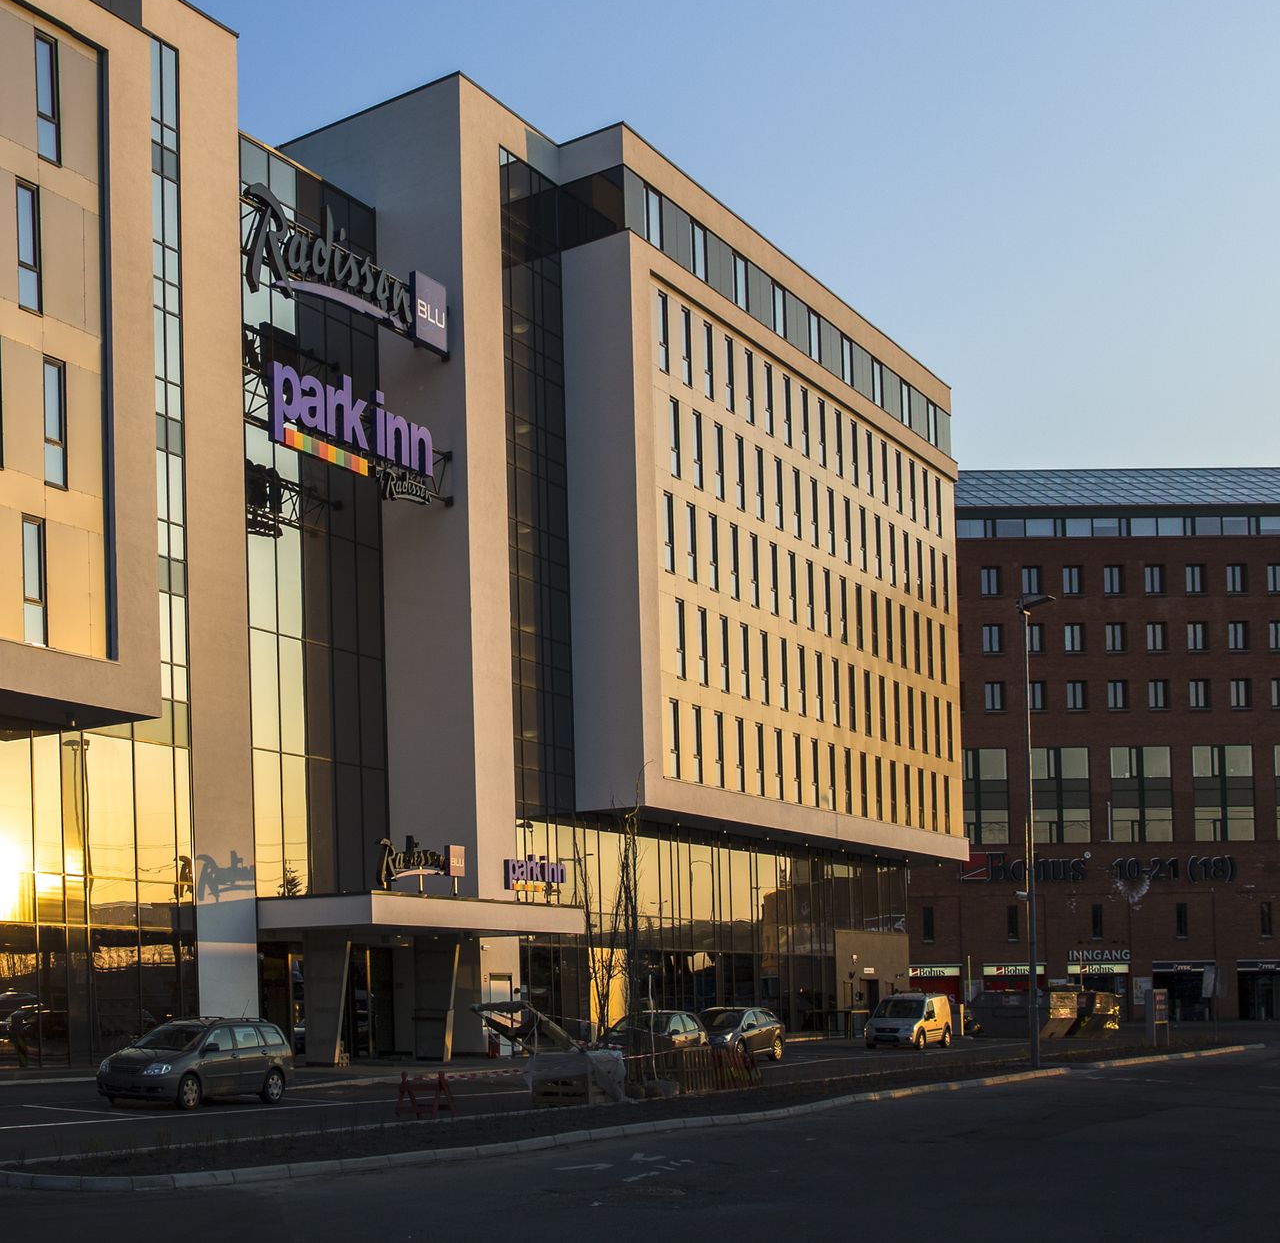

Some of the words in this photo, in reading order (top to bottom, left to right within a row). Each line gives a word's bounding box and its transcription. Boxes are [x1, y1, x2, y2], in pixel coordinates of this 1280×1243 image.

[243, 183, 413, 324] Radisson
[417, 299, 446, 329] BLU
[272, 360, 370, 451] park
[374, 390, 433, 478] inn
[386, 468, 433, 503] Radisson
[450, 857, 464, 867] BLU
[506, 855, 541, 889] park
[542, 857, 567, 884] inn
[1111, 857, 1180, 881] 10-21
[1187, 854, 1238, 884] (18)
[1003, 965, 1030, 975] Bohus
[1068, 949, 1131, 961] INNGANG
[1087, 964, 1115, 974] Bohus
[919, 967, 946, 977] Bohus
